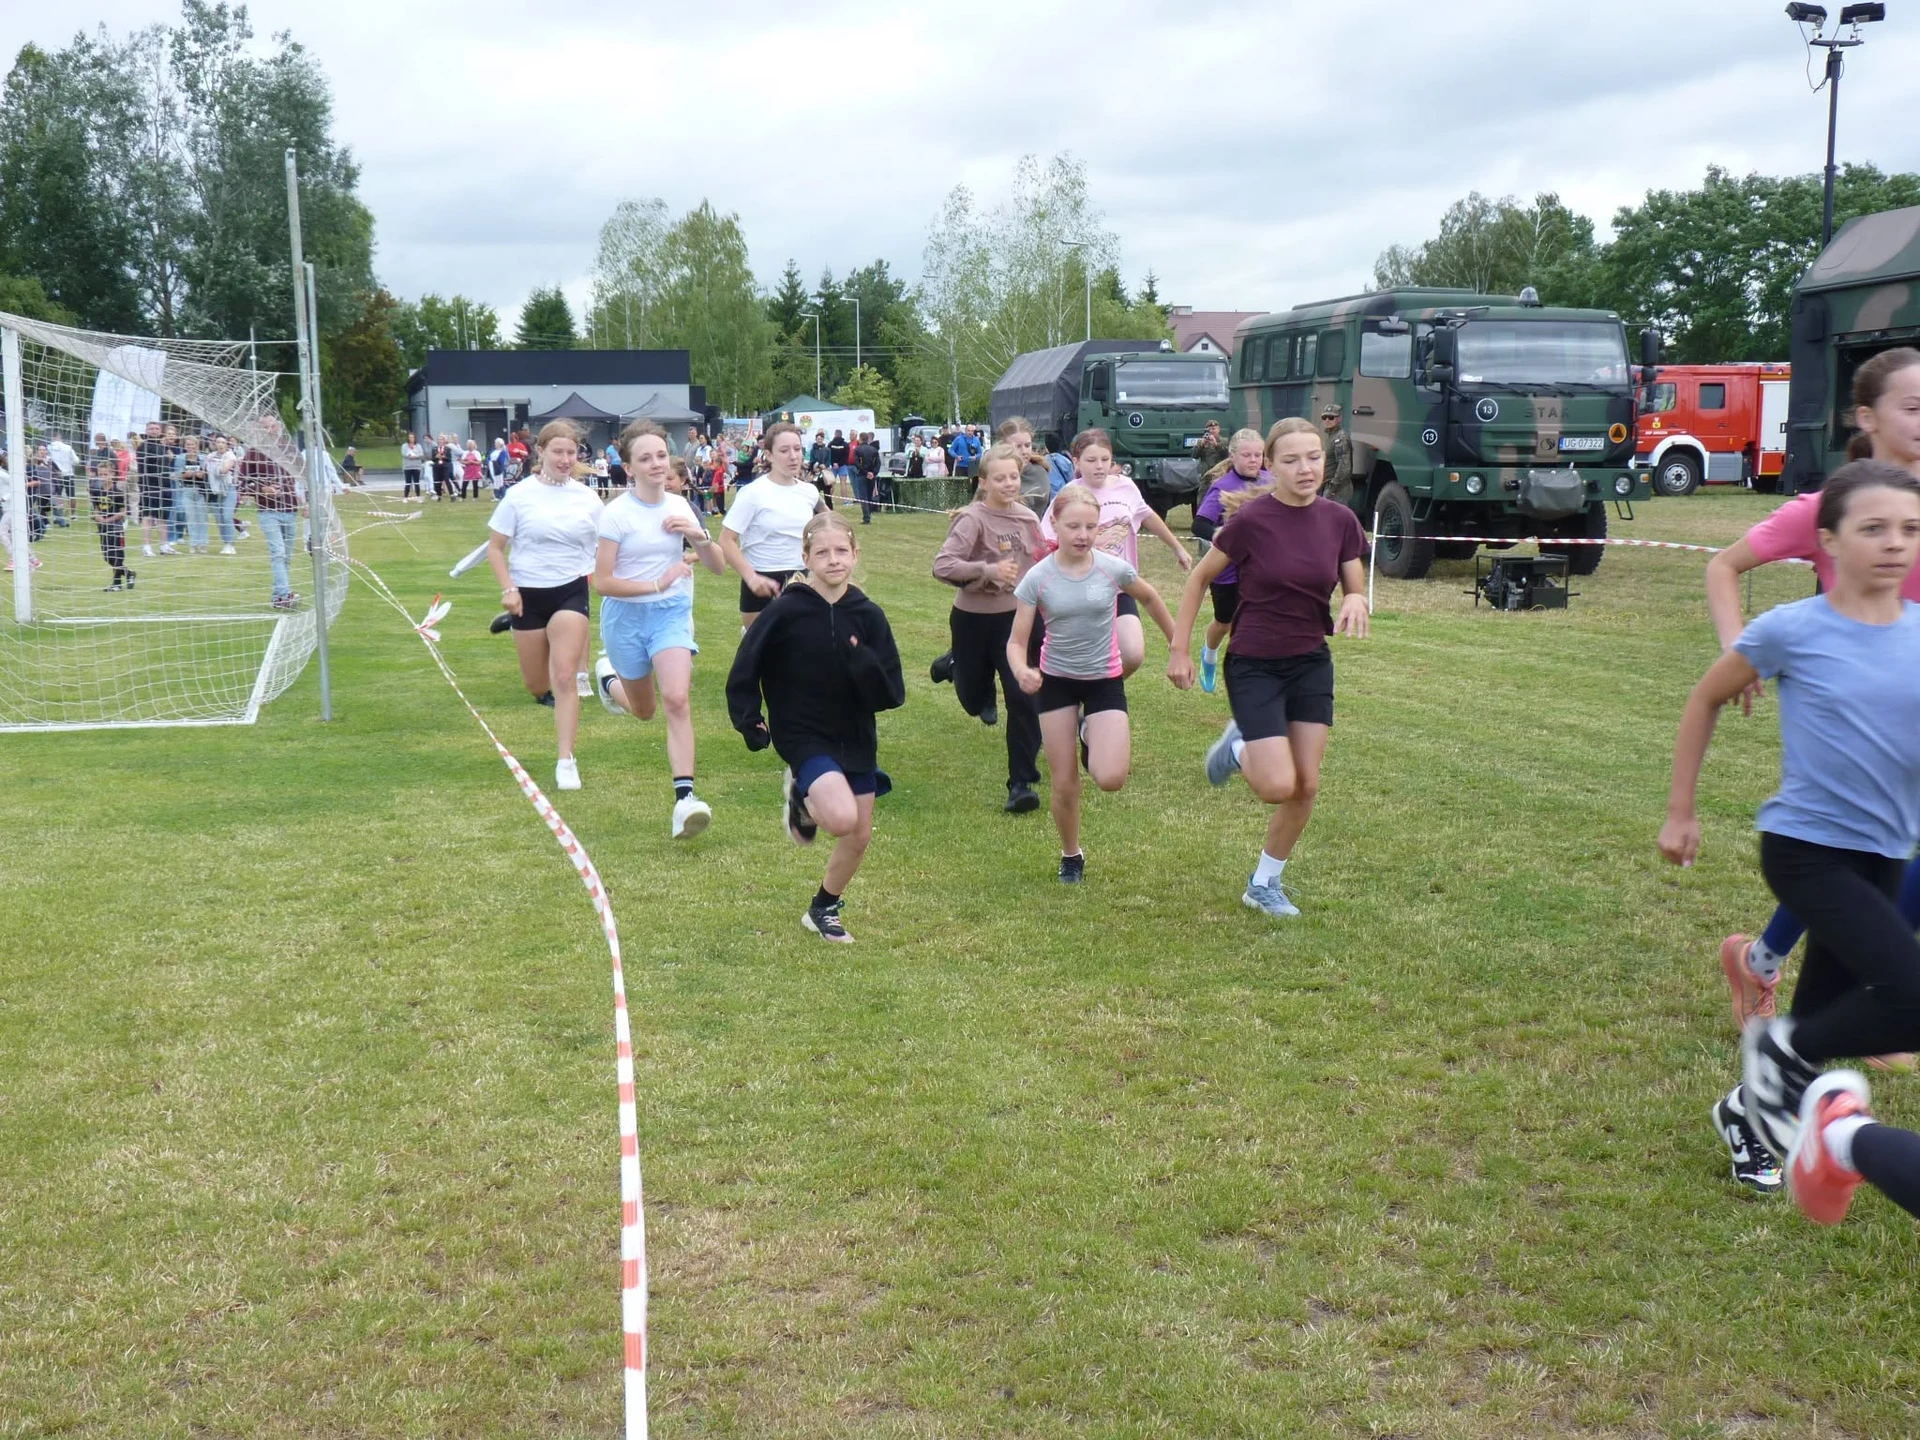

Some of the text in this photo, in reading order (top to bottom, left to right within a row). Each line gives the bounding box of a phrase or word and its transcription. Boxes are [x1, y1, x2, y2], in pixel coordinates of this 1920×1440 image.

[1482, 405, 1493, 415] 13
[1524, 407, 1569, 418] STAR
[1425, 433, 1435, 441] 13
[1564, 438, 1603, 448] UG 07322
